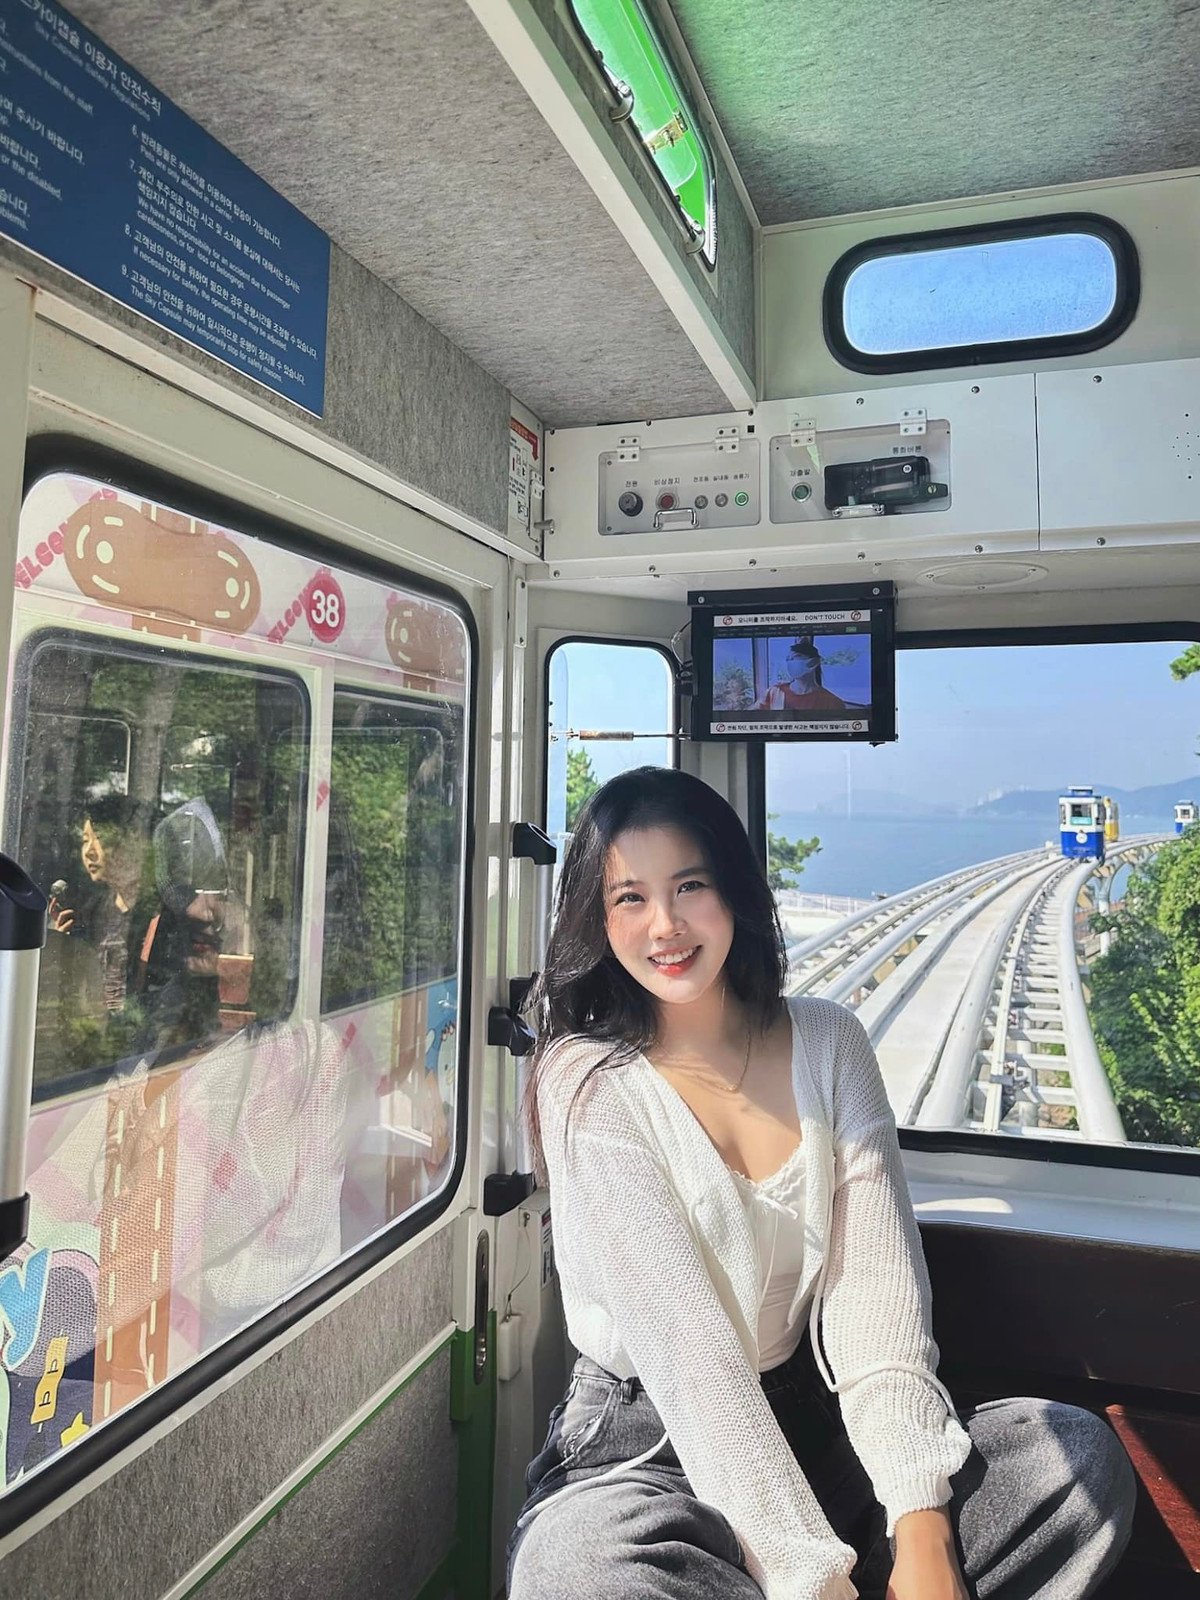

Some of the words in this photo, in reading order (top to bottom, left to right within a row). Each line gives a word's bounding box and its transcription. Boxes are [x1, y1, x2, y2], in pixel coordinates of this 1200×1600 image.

[19, 0, 79, 48] 카이캡슐
[84, 42, 117, 79] 이용자
[120, 71, 161, 115] 안전수칙
[16, 107, 44, 136] 주시기
[47, 129, 85, 165] 바랍니다.
[110, 83, 150, 121] Regulations
[0, 129, 40, 170] 바랍니다.
[12, 160, 25, 175] the
[27, 171, 62, 200] disabled.
[167, 168, 180, 183] only
[181, 178, 203, 199] allowed
[138, 181, 167, 209] 책임지지
[168, 202, 198, 233] 않습니다.
[138, 166, 154, 185] 개인
[156, 180, 184, 207] 부주의로
[185, 200, 199, 218] 인한
[200, 213, 213, 229] 사고
[243, 244, 260, 264] 분실에
[262, 257, 283, 281] 대해서는
[141, 132, 177, 167] 반려동물은
[179, 161, 205, 189] 캐리어를
[207, 183, 232, 210] 이용하여
[233, 204, 251, 225] 탑승이
[252, 218, 281, 249] 가능합니다.
[138, 196, 148, 209] We
[149, 204, 165, 221] have
[175, 224, 211, 255] responsibility
[229, 262, 250, 281] accident
[266, 289, 290, 309] passenger
[197, 250, 208, 264] loss
[130, 270, 161, 297] 고객님의
[163, 289, 183, 311] 안전을
[185, 303, 205, 324] 위하여
[207, 317, 238, 343] 일시적으로
[239, 337, 257, 356] 운행이
[258, 348, 275, 367] 정지될
[283, 364, 305, 385] 있습니다.
[131, 284, 143, 299] The
[144, 293, 157, 308] Sky
[157, 301, 182, 322] Capsule
[183, 318, 196, 331] may
[196, 324, 226, 350] temporarily
[227, 344, 238, 356] stop
[247, 356, 262, 371] safety
[134, 230, 164, 258] 고객님의
[165, 251, 186, 272] 안전을
[188, 266, 208, 287] 위하여
[210, 280, 229, 300] 필요한
[230, 293, 242, 308] 경우
[243, 303, 272, 329] 운행시간을
[273, 322, 289, 341] 조정할
[296, 338, 318, 360] 있습니다.
[139, 251, 171, 277] necessary
[211, 297, 235, 319] operating
[236, 312, 247, 325] time
[248, 321, 259, 334] may
[312, 589, 340, 628] 38
